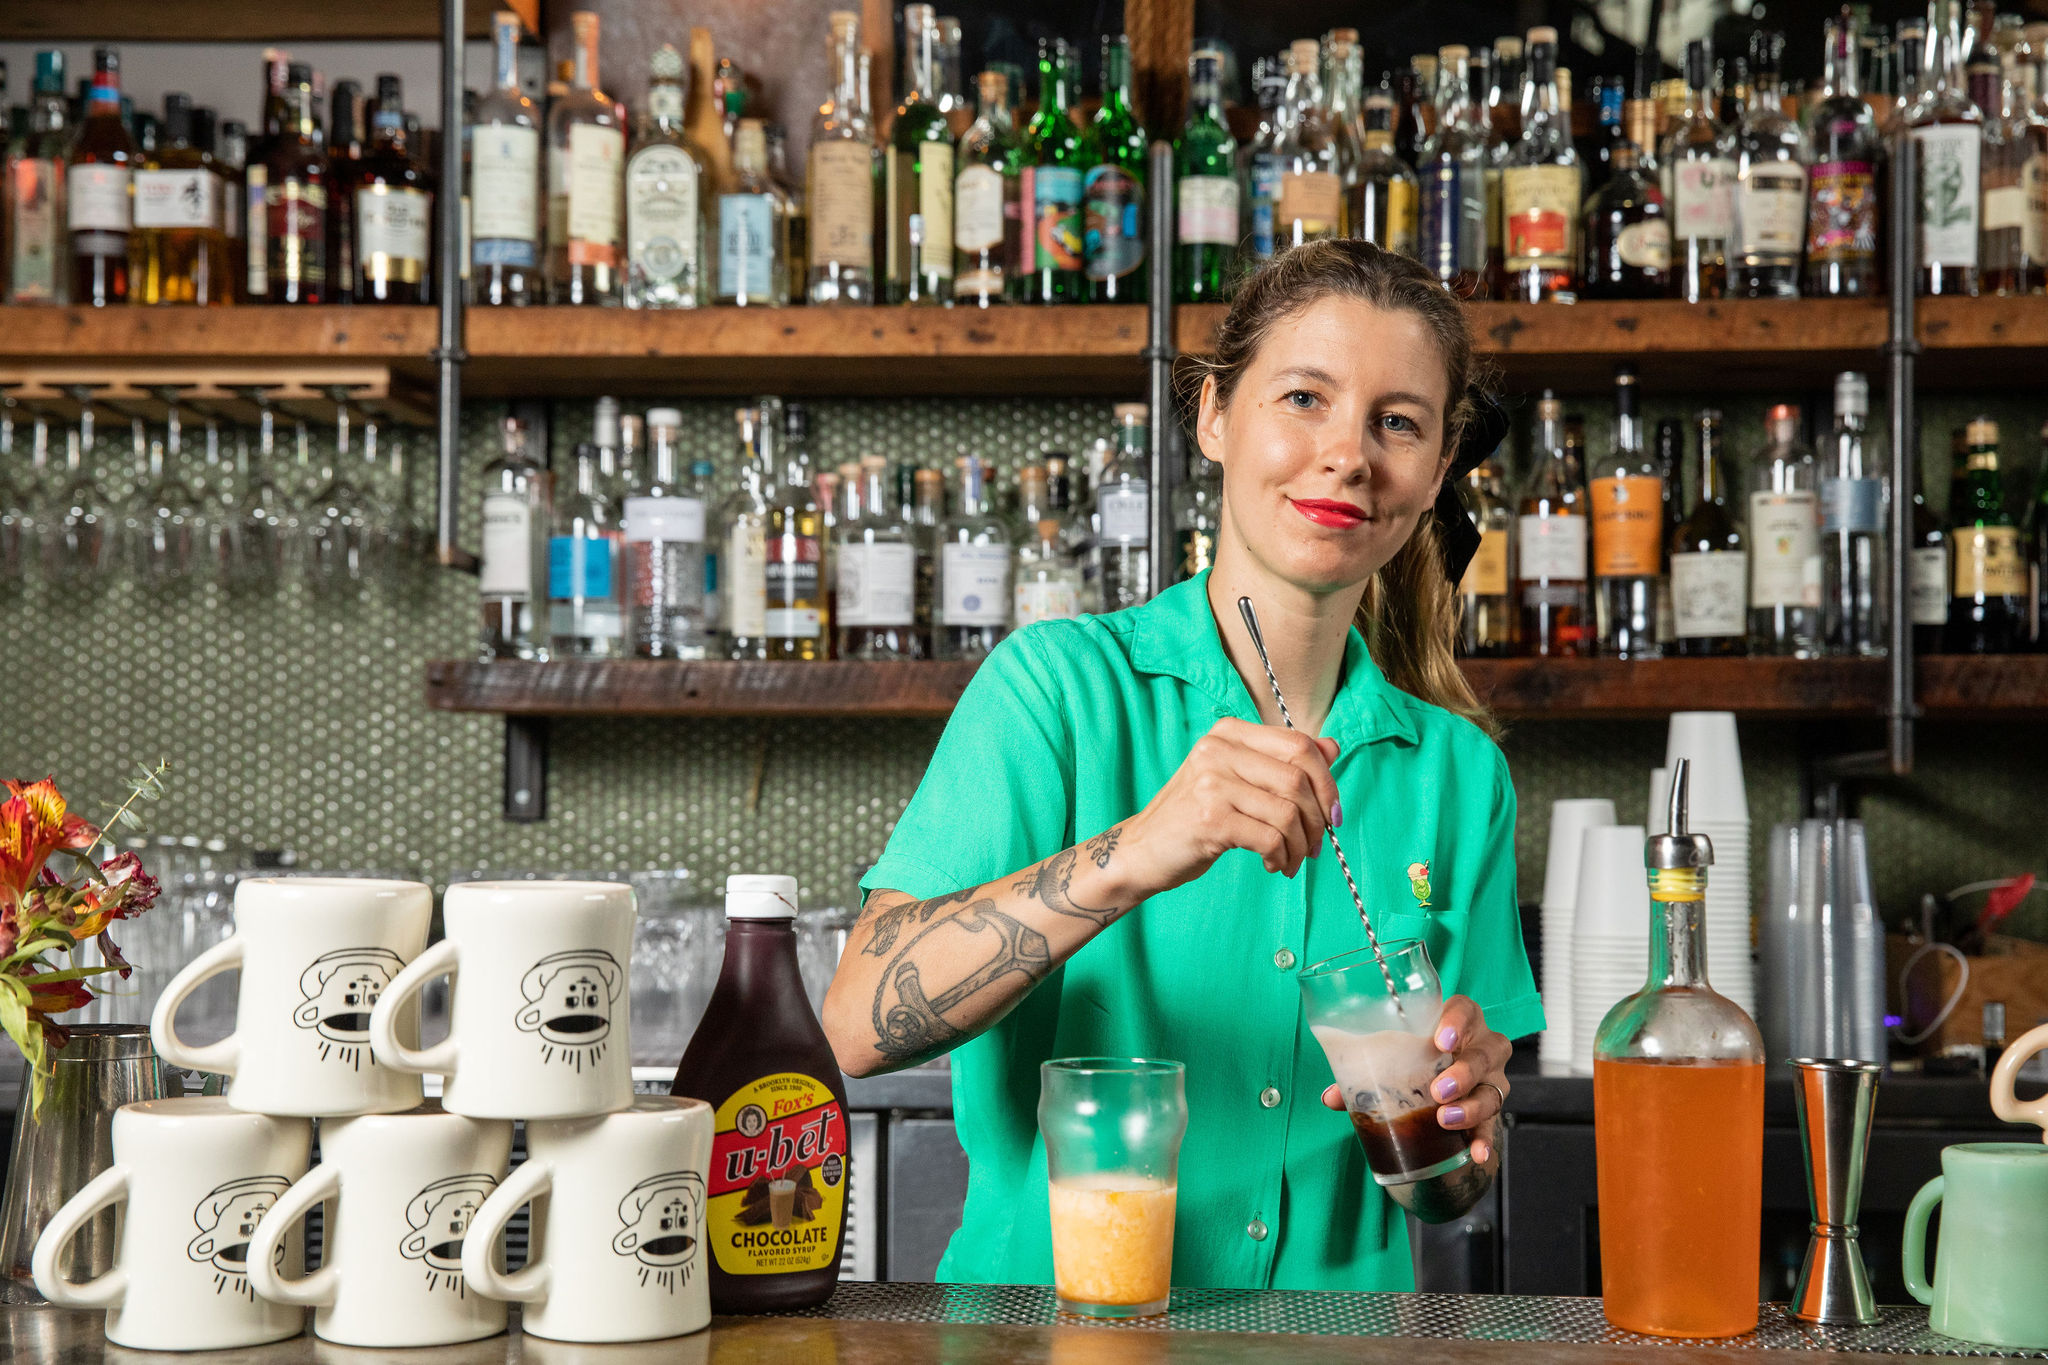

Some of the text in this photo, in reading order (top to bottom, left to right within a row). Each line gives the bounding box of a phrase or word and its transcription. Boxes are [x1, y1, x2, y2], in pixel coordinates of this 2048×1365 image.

[759, 1078, 790, 1090] BROOKLYN
[791, 1078, 816, 1091] ORIGINAL
[770, 1084, 788, 1092] SINCE
[772, 1093, 814, 1116] Fox's
[726, 1109, 837, 1182] u-bet
[731, 1227, 827, 1248] CHOCOLATE
[748, 1245, 816, 1257] FLAVORED SYRUP
[756, 1258, 769, 1267] NET
[769, 1258, 778, 1266] WT
[778, 1257, 786, 1266] 22
[787, 1256, 794, 1265] OZ
[795, 1255, 811, 1265] (624g)
